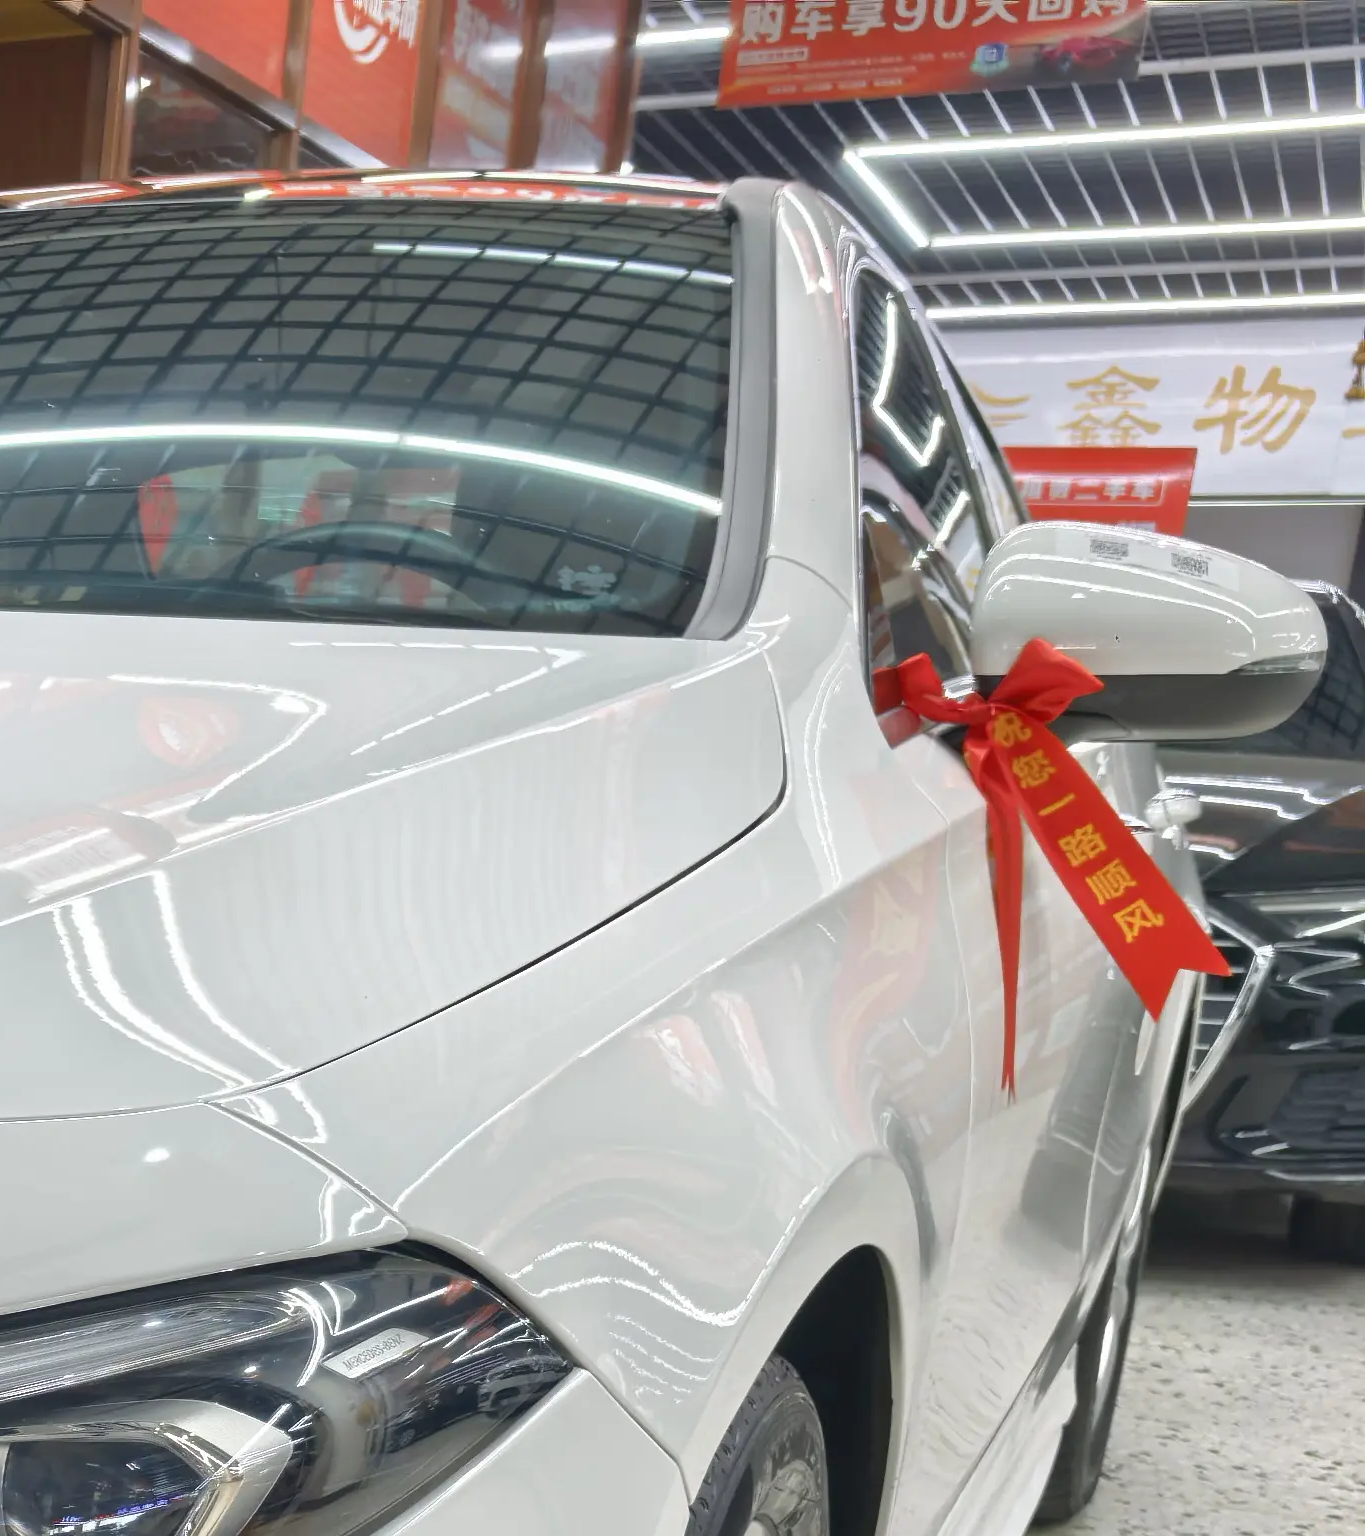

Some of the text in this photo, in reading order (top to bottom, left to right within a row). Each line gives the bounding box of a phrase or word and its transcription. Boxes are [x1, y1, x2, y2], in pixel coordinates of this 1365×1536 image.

[992, 712, 1164, 943] 祝您一路顺风
[342, 1333, 405, 1371] MERCEDES-BENZ
